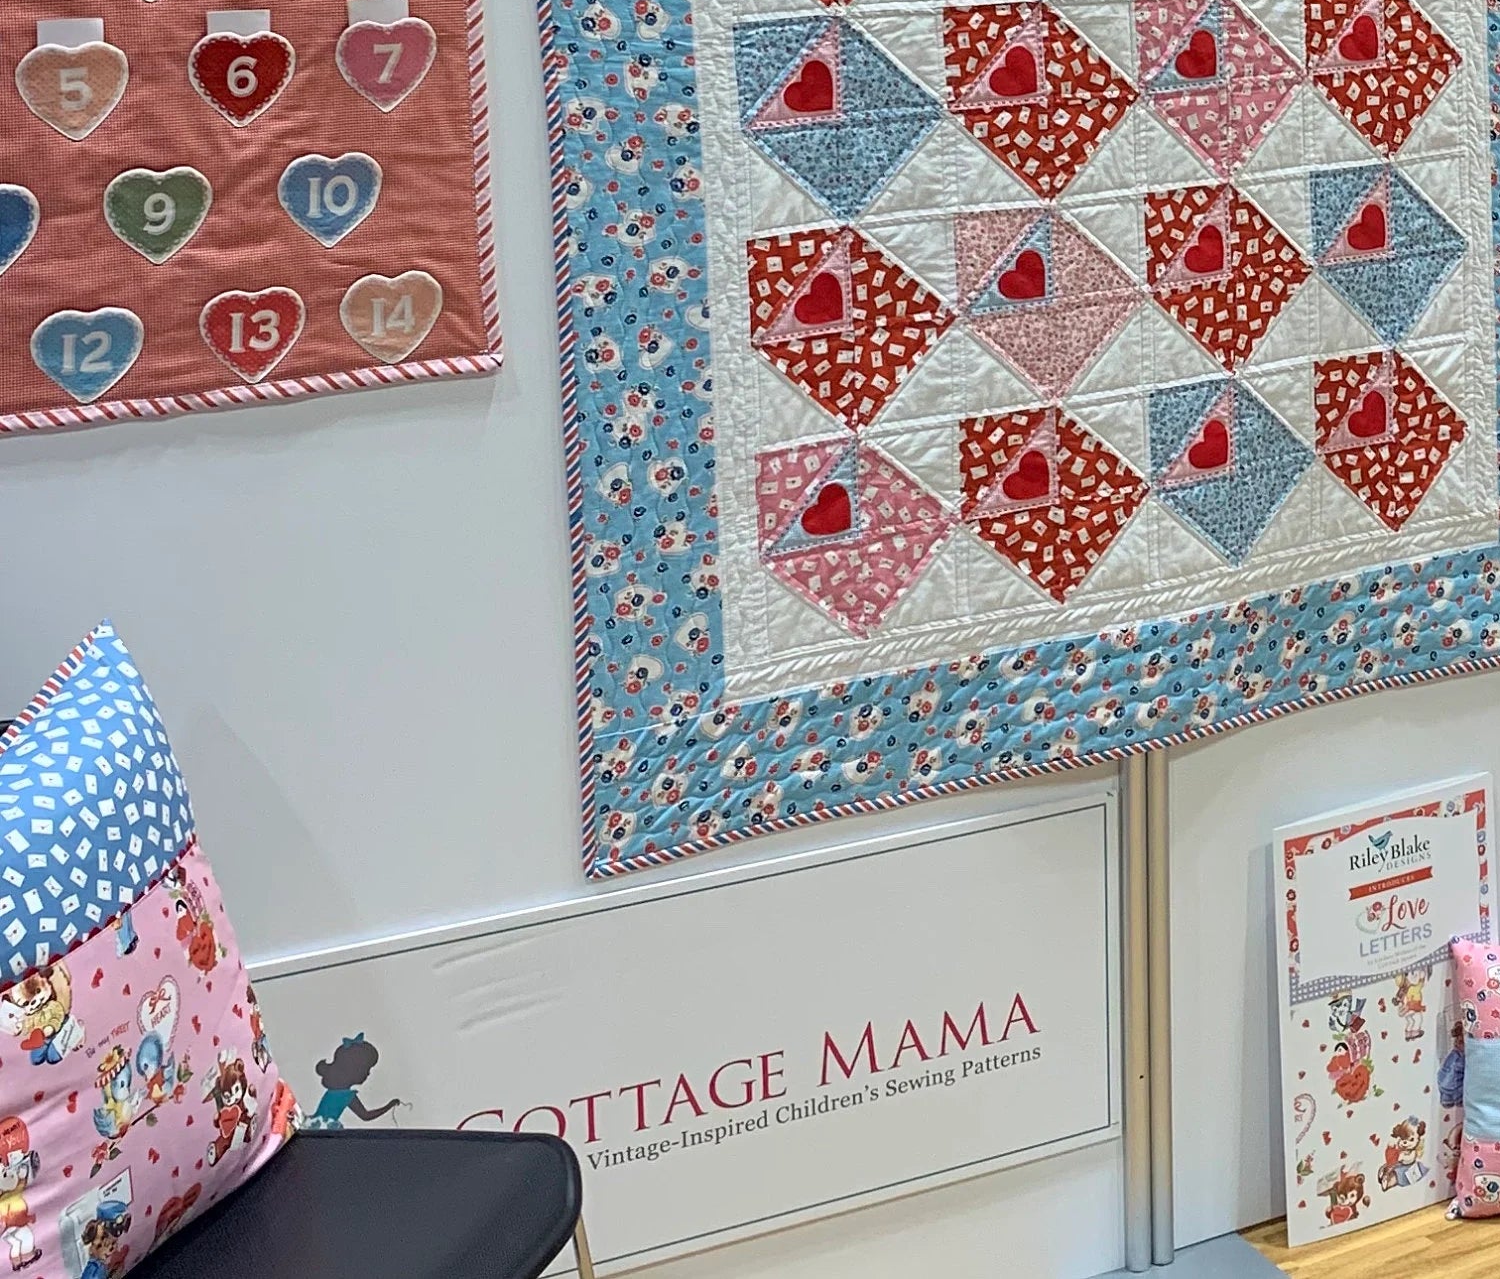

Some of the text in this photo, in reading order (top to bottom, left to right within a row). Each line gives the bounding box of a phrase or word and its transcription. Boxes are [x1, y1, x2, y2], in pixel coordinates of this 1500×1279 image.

[226, 56, 258, 97] 6
[373, 43, 402, 83] 7
[59, 66, 92, 110] 5
[143, 192, 175, 235] 9
[307, 175, 357, 218] 10
[228, 309, 280, 353] 13
[369, 295, 414, 338] 14
[61, 331, 112, 374] 12
[1349, 834, 1431, 872] Riley Blake
[1386, 852, 1432, 871] DESIGNS
[1381, 894, 1430, 932] Love
[1360, 923, 1432, 957] LETTERS
[817, 992, 1042, 1087] MAMA
[587, 1107, 769, 1171] Vintage-Inspired
[885, 1063, 956, 1098] Sewing
[962, 1044, 1042, 1079] Patterns
